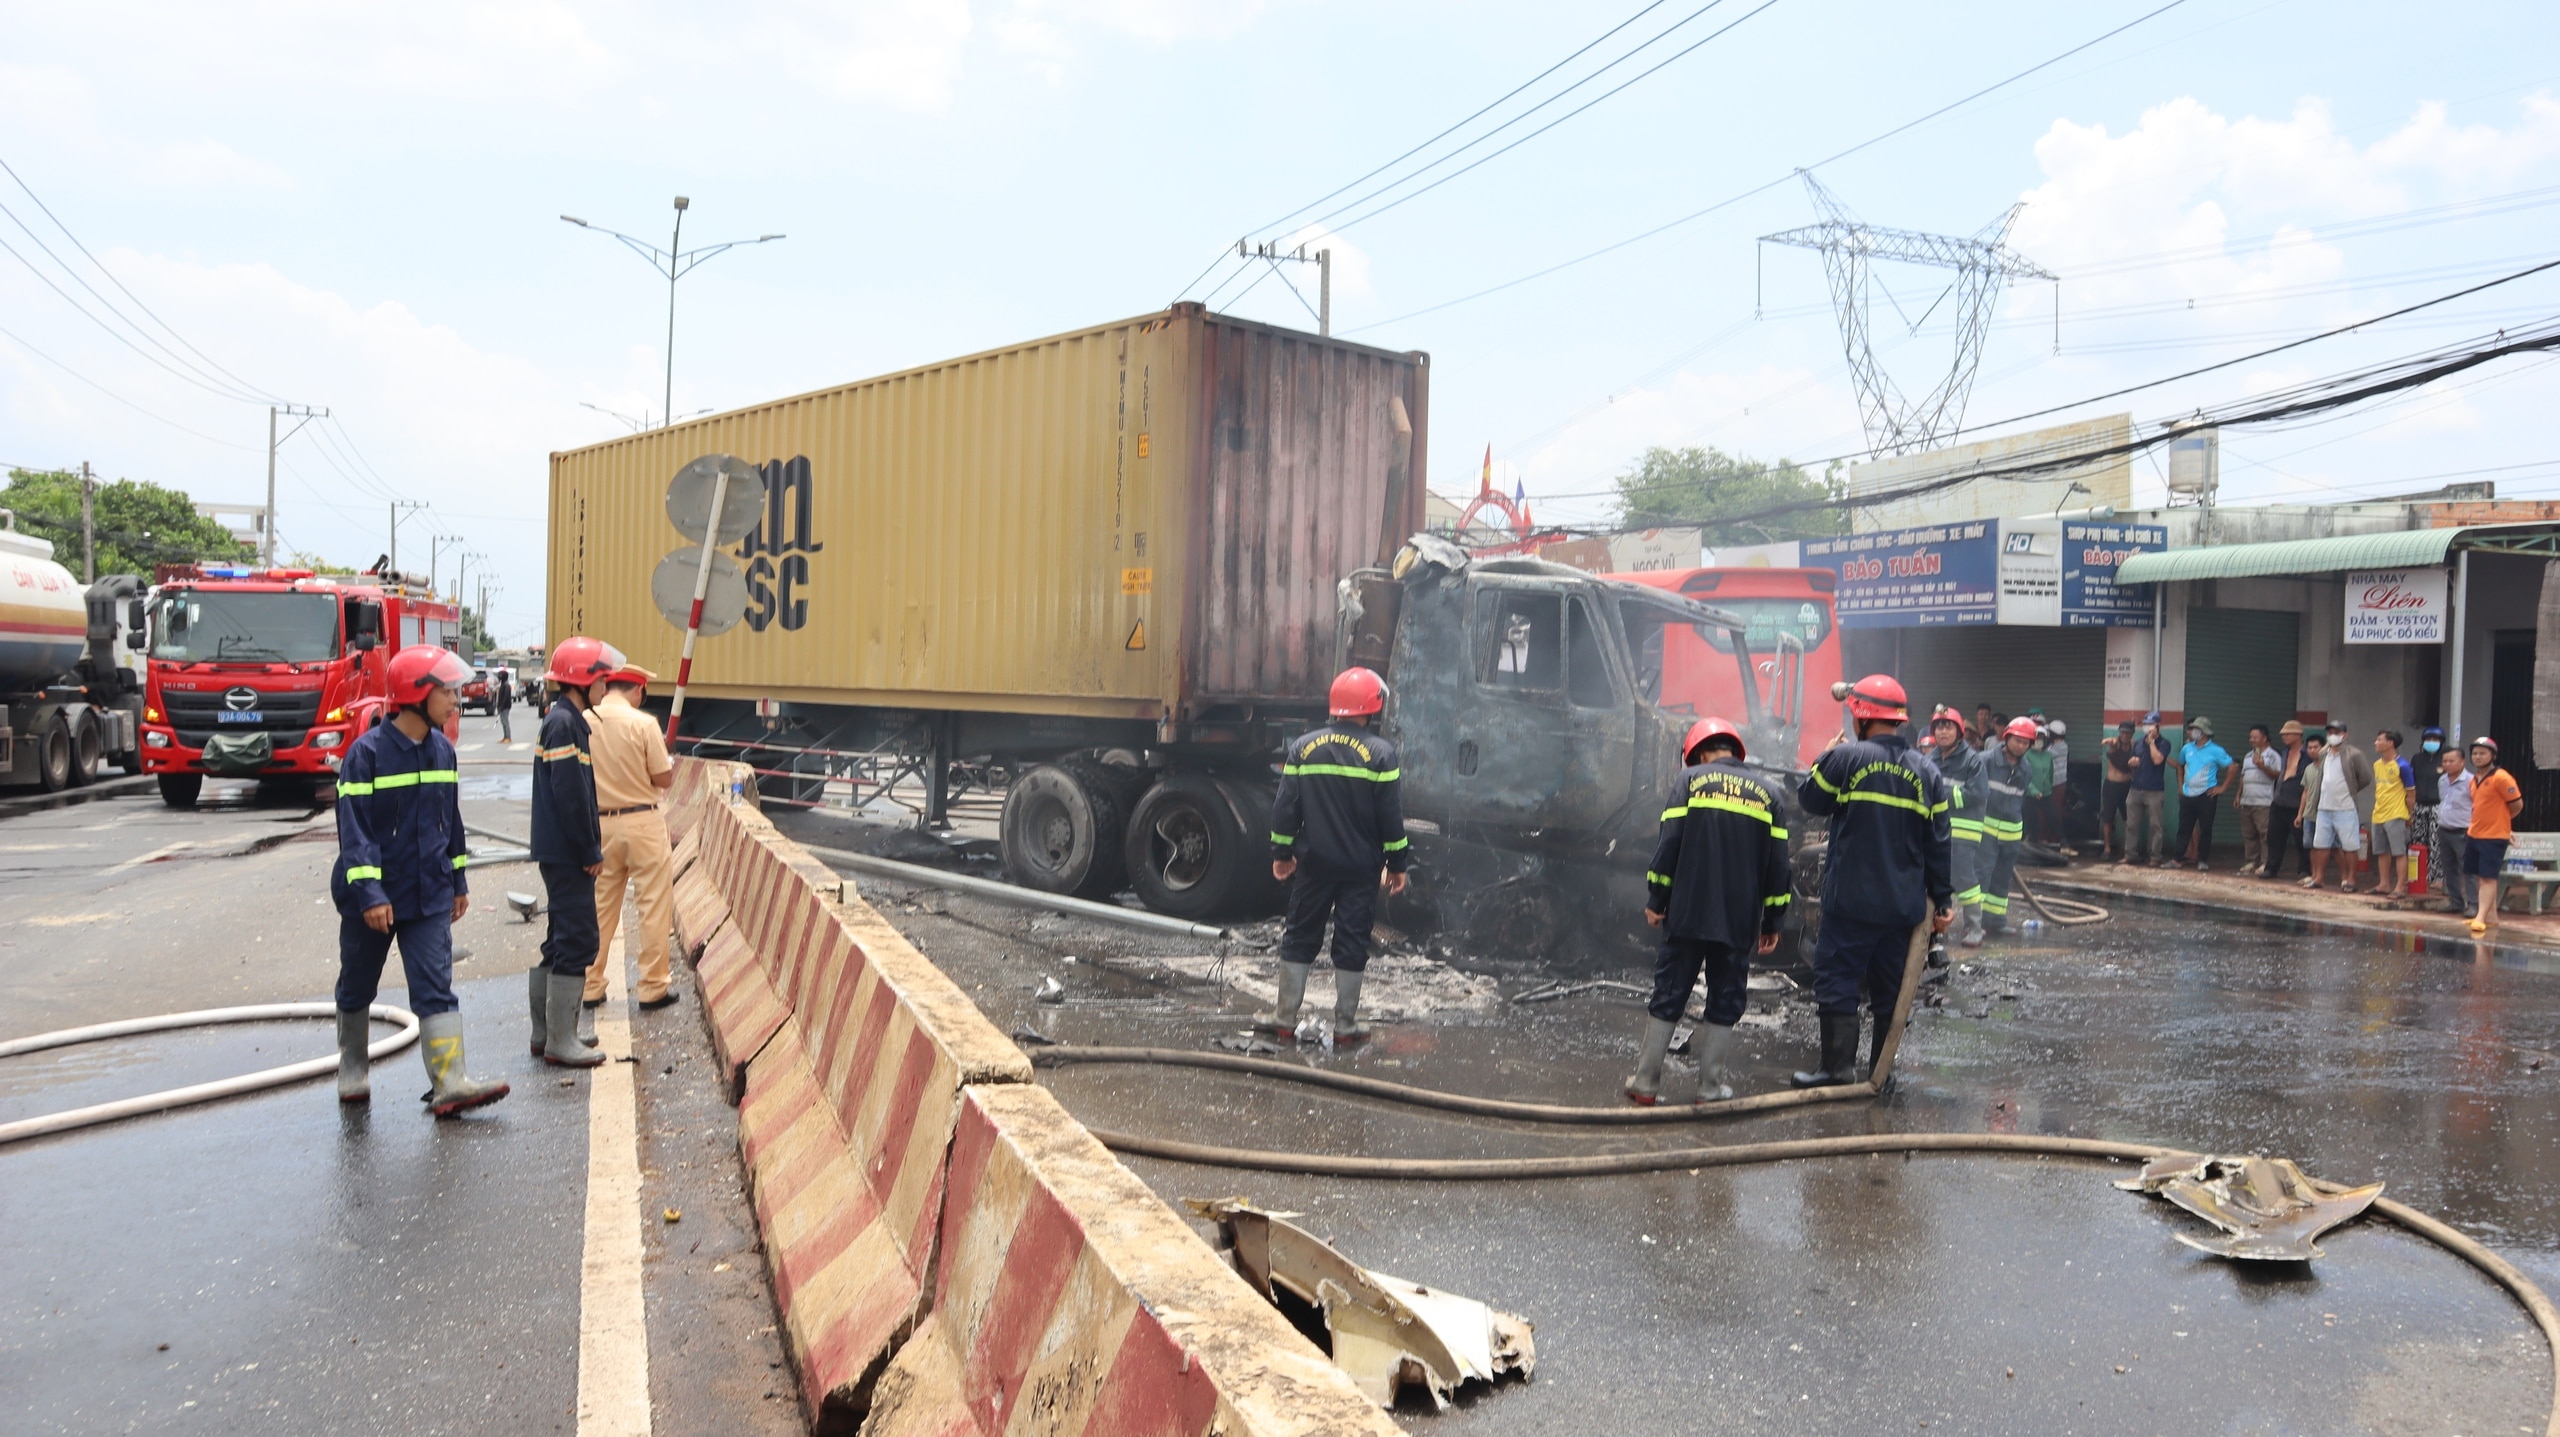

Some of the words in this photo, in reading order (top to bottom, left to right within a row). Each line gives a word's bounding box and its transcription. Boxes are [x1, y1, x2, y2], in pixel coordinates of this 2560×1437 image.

[1806, 541, 1831, 557] TRUNG
[1949, 527, 1962, 542] XE
[1964, 522, 1986, 540] MÁY
[2005, 534, 2031, 552] HD
[2067, 526, 2086, 541] SHOP
[2152, 531, 2162, 545] XE
[1843, 553, 1883, 581] BẢO
[1887, 546, 1941, 578] TUẤN
[2083, 544, 2113, 566] BẢO
[2378, 573, 2407, 583] MAY
[2358, 584, 2428, 610] Liên
[2387, 615, 2438, 626] VESTON
[2366, 627, 2393, 640] PHỤC
[1723, 782, 1742, 796] 114
